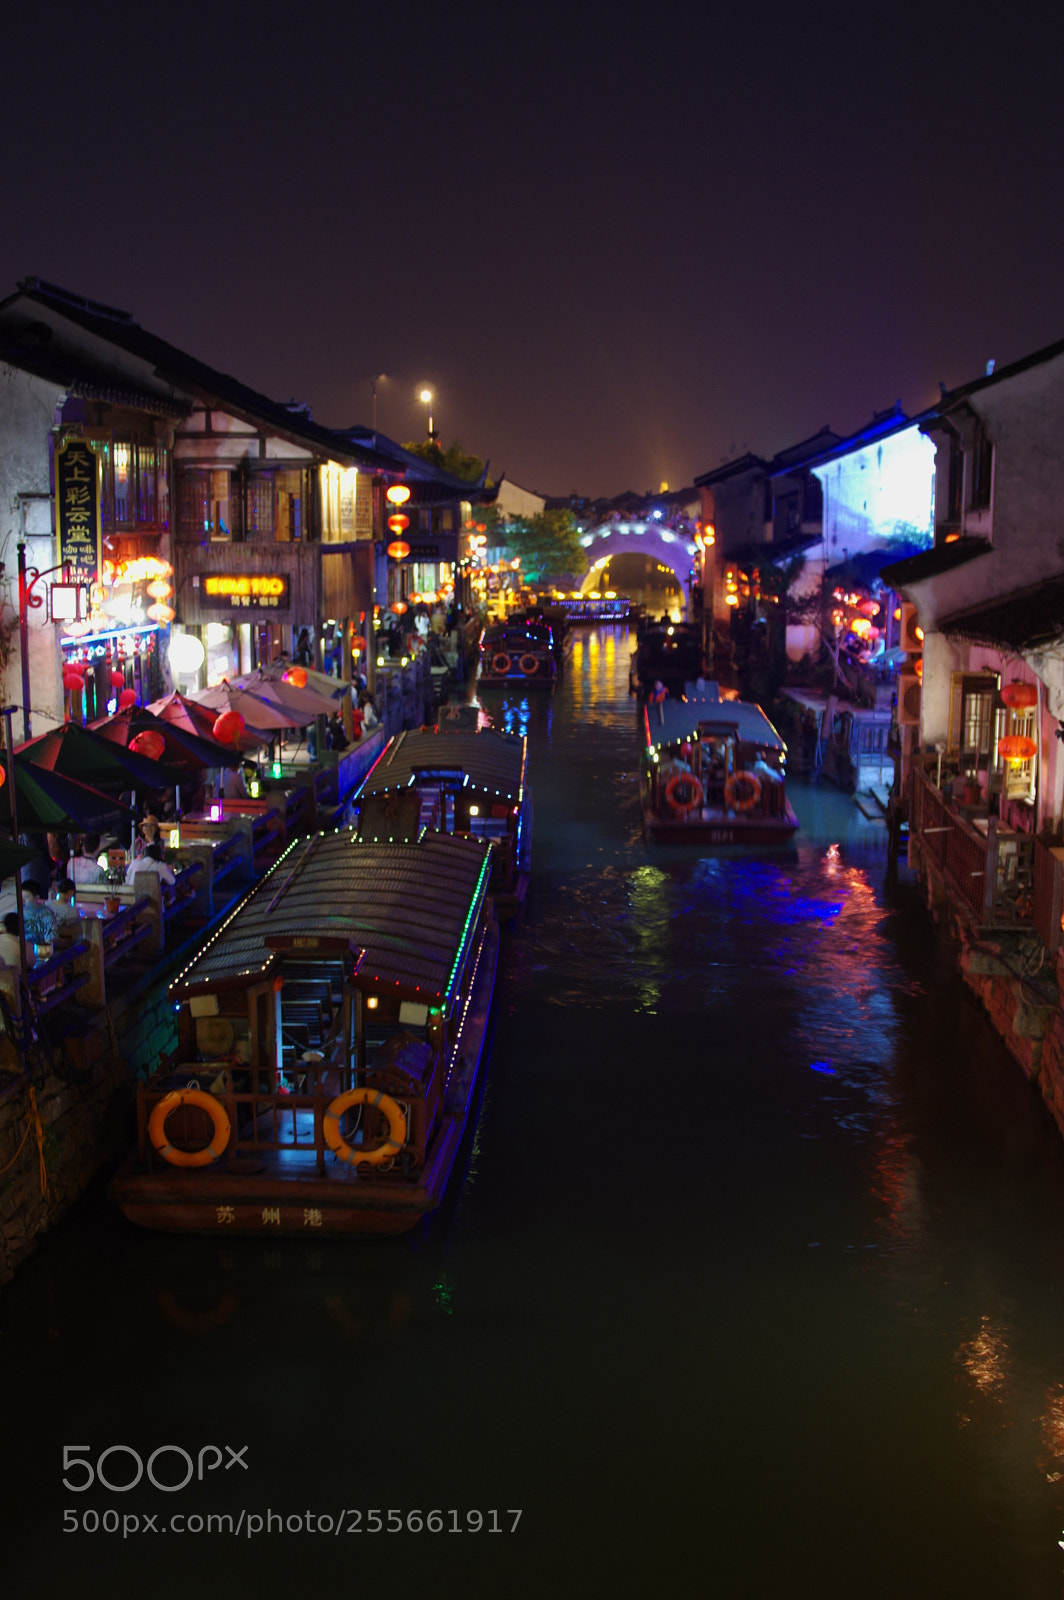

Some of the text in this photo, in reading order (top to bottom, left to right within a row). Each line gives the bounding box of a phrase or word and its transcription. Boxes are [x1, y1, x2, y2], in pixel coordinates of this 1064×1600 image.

[64, 449, 92, 544] 天上彩云堂
[215, 1205, 323, 1227] 苏州港
